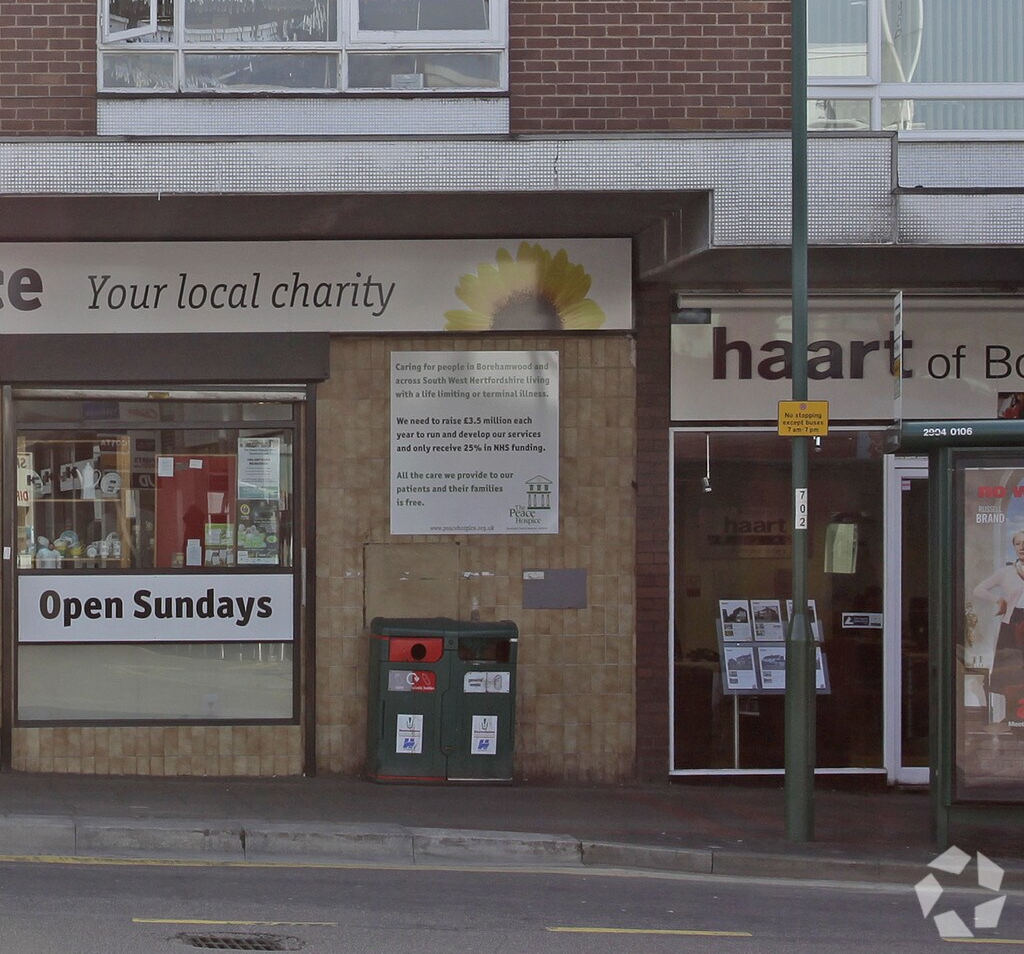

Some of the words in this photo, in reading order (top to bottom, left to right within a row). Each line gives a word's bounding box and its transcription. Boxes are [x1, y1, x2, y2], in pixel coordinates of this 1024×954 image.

[88, 276, 167, 309] Your
[178, 273, 260, 309] local
[272, 272, 395, 316] charity
[713, 327, 912, 380] haart
[927, 344, 967, 379] of
[395, 363, 422, 372] Caring
[423, 363, 435, 371] for
[437, 363, 465, 372] people
[466, 363, 475, 371] in
[476, 362, 533, 371] Borehamwood
[534, 363, 549, 371] and
[422, 376, 447, 385] South
[447, 376, 468, 385] West
[469, 376, 525, 385] Hertfordshire
[526, 376, 550, 386] living
[395, 390, 414, 398] with
[421, 390, 437, 399] life
[437, 390, 471, 400] limiting
[482, 390, 518, 398] terminal
[519, 389, 549, 398] illness.
[396, 417, 409, 425] We
[410, 417, 430, 425] need
[431, 417, 440, 425] to
[441, 417, 462, 425] raise
[463, 416, 482, 425] £3.5
[483, 416, 512, 425] million
[513, 417, 533, 425] each
[795, 412, 823, 420] stopping
[396, 432, 415, 441] year
[441, 431, 457, 439] and
[458, 430, 491, 440] develop
[507, 430, 542, 438] services
[950, 427, 973, 436] 0106
[396, 444, 412, 452] and
[412, 444, 432, 454] only
[432, 443, 462, 452] receive
[463, 443, 483, 452] 25%
[483, 443, 492, 452] in
[493, 443, 510, 452] NHS
[511, 443, 546, 454] funding.
[396, 471, 409, 480] All
[410, 471, 424, 480] the
[457, 471, 488, 481] provide
[489, 471, 499, 479] to
[396, 484, 431, 494] patients
[431, 484, 447, 493] and
[448, 484, 469, 493] their
[470, 484, 504, 493] families
[977, 485, 1007, 499] no
[396, 498, 404, 506] is
[405, 498, 425, 507] free.
[508, 509, 536, 518] Peace
[975, 513, 1005, 524] BRAND
[515, 517, 541, 525] Hospice
[725, 516, 786, 534] haart
[40, 590, 122, 627] Open
[134, 589, 272, 626] Sundays
